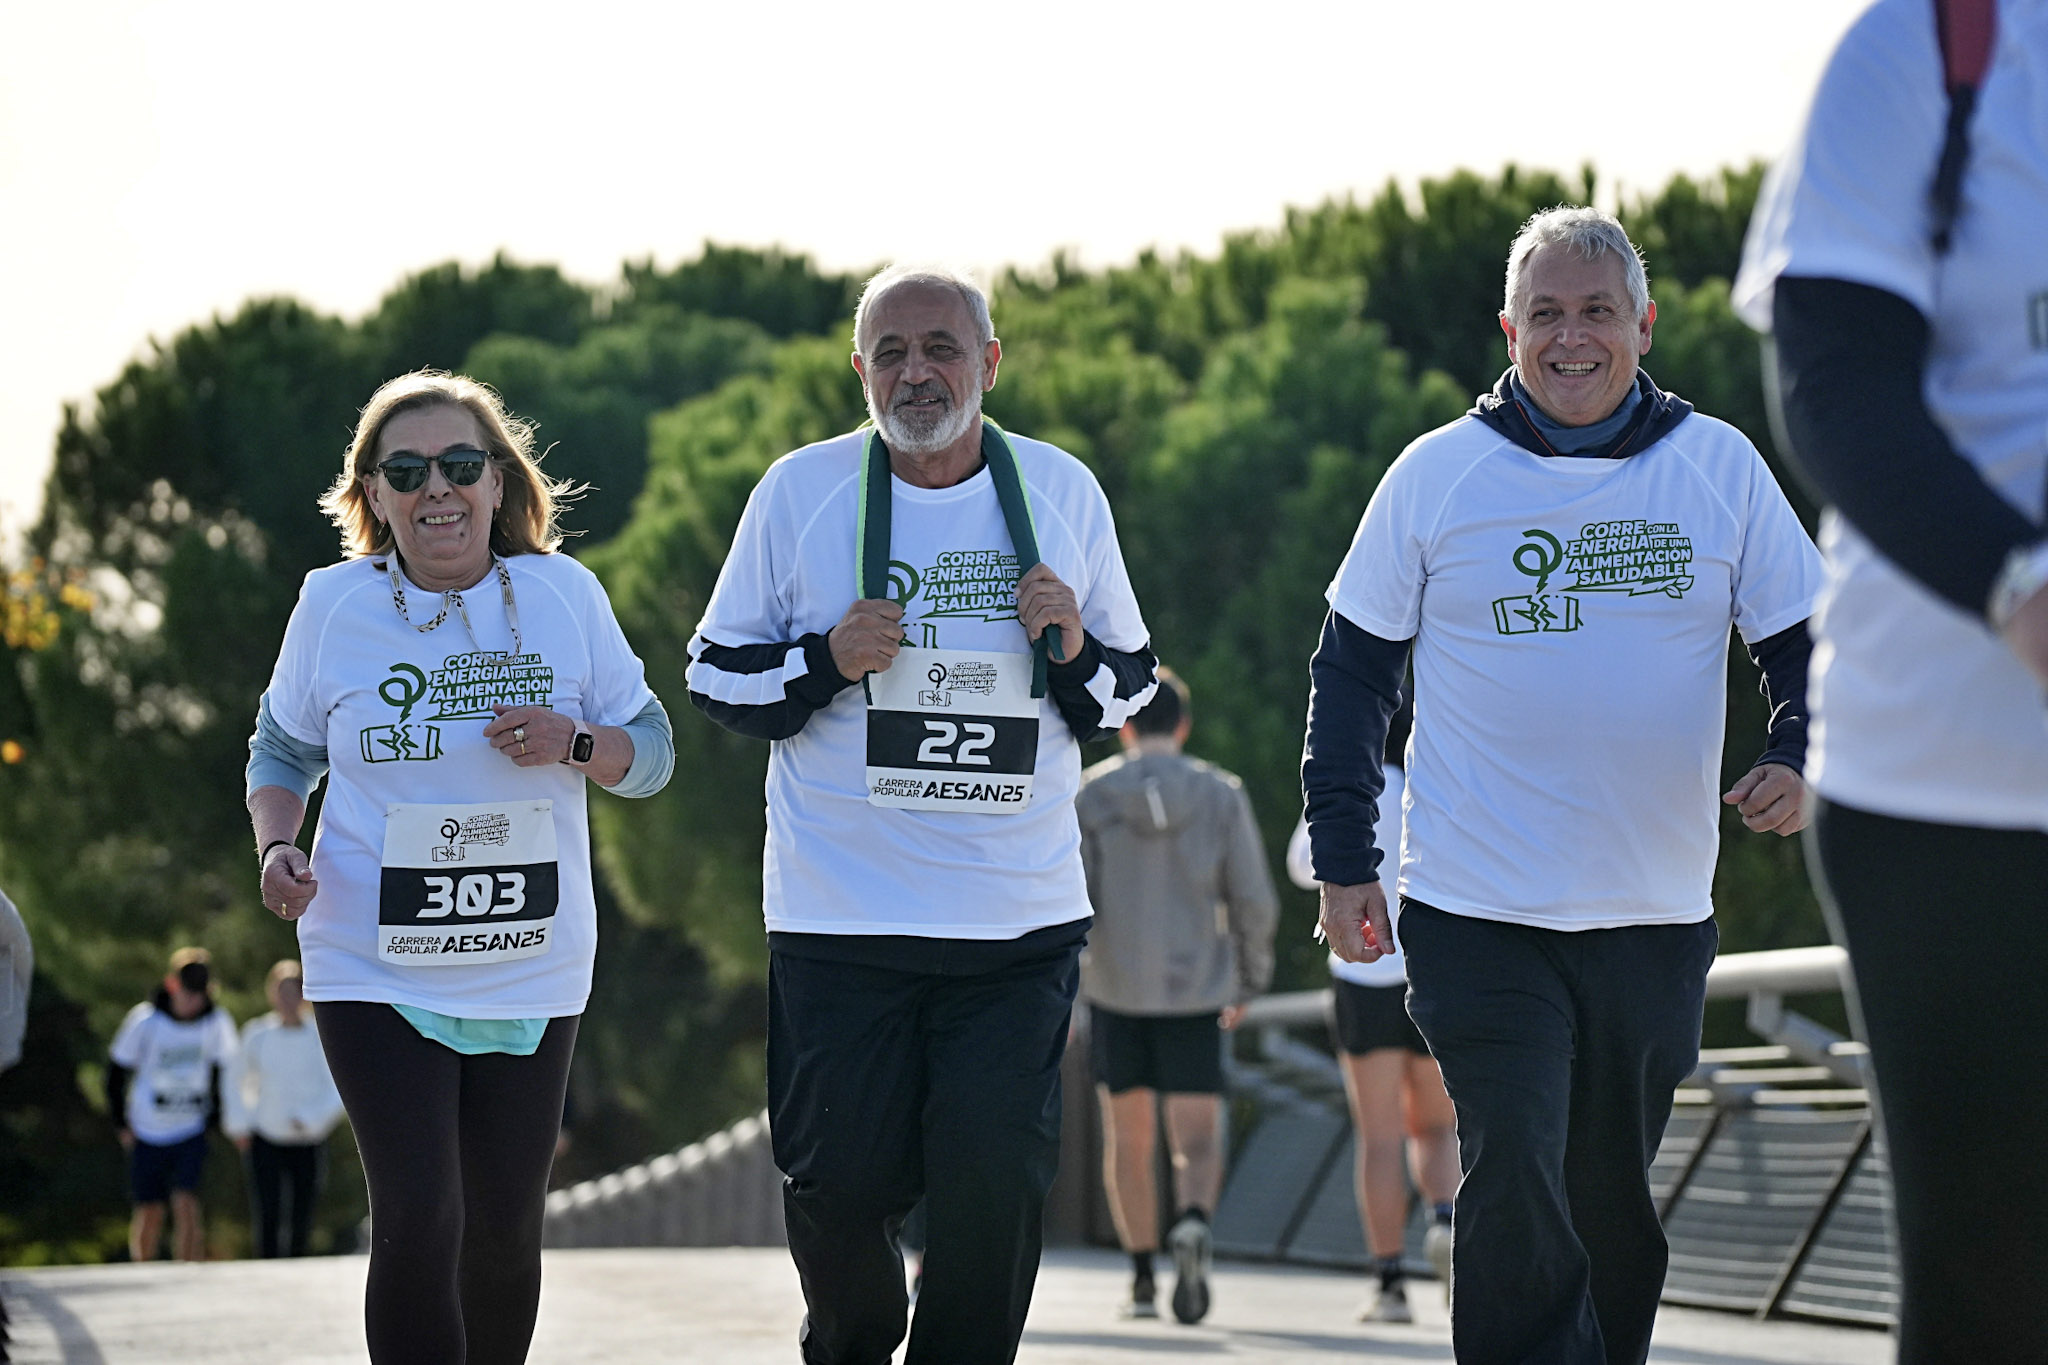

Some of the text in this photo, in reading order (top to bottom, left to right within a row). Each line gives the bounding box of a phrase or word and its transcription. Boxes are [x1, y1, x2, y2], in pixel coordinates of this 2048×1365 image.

[1581, 520, 1678, 540] CORRE CON LA
[1654, 539, 1668, 548] DE
[1670, 538, 1689, 547] UNA
[938, 552, 1017, 567] CORRE CON
[1569, 547, 1691, 571] ALIMENTACIÓN
[1006, 570, 1020, 579] DE
[1579, 563, 1684, 585] SALUDABLE
[926, 580, 1018, 598] ALIMENTAC
[936, 593, 1018, 611] SALUDAB
[528, 655, 540, 664] LA
[515, 669, 528, 679] DE
[530, 668, 552, 677] UNA
[433, 677, 551, 701] ALIMENTACIÓN
[917, 720, 996, 766] 22
[878, 778, 923, 789] CARRERA
[873, 786, 920, 798] POPULAR
[921, 781, 1026, 803] AESAN25
[468, 814, 492, 823] CORRE
[415, 871, 527, 919] 303
[391, 936, 441, 945] CARRERA
[440, 927, 547, 953] AESAN25
[386, 944, 438, 954] POPULAR
